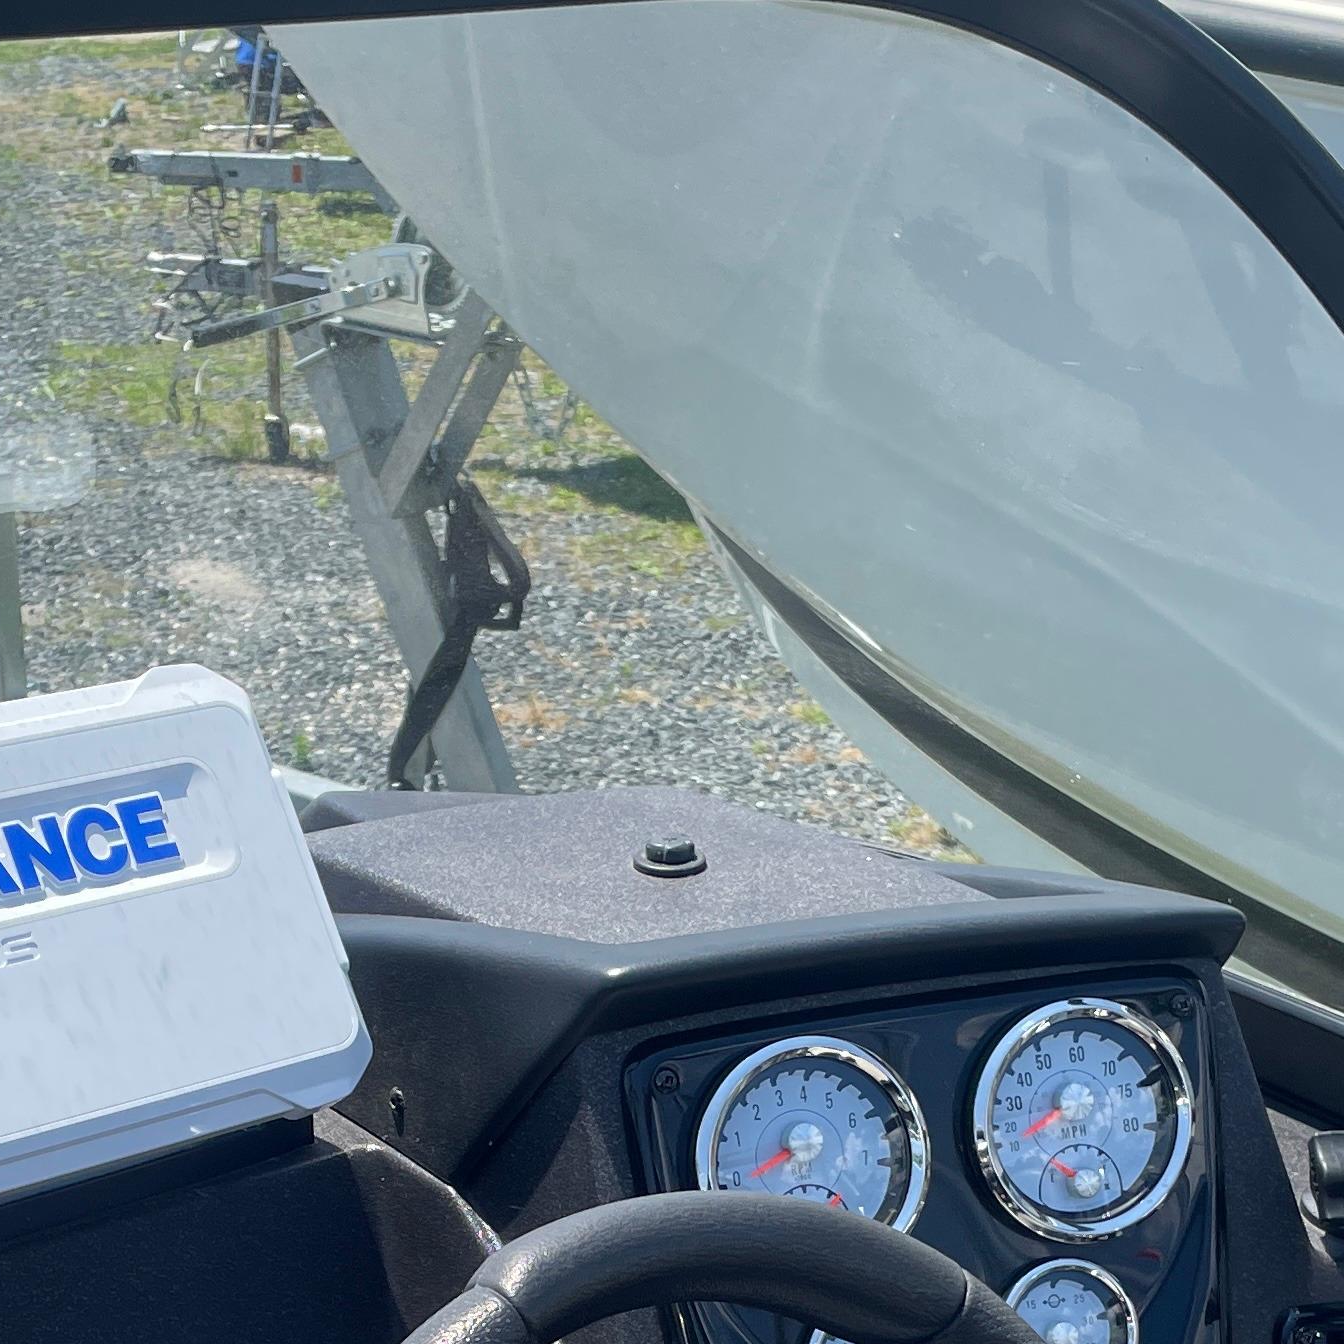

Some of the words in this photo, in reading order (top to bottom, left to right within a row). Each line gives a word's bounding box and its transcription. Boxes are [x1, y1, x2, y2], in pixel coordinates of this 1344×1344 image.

[1035, 1053, 1052, 1071] 50
[1069, 1045, 1085, 1063] 60
[1102, 1060, 1116, 1077] 70
[1017, 1072, 1033, 1088] 40
[775, 1089, 784, 1107] 3
[799, 1085, 808, 1102] 4
[1118, 1083, 1133, 1099] 75
[825, 1092, 834, 1109] 5
[1006, 1095, 1023, 1112] 30
[752, 1104, 762, 1121] 2
[848, 1112, 857, 1129] 6
[1004, 1121, 1017, 1133] 20
[1060, 1124, 1087, 1140] MPH
[1123, 1117, 1139, 1133] 80
[734, 1131, 741, 1147] 1
[732, 1170, 741, 1187] 0
